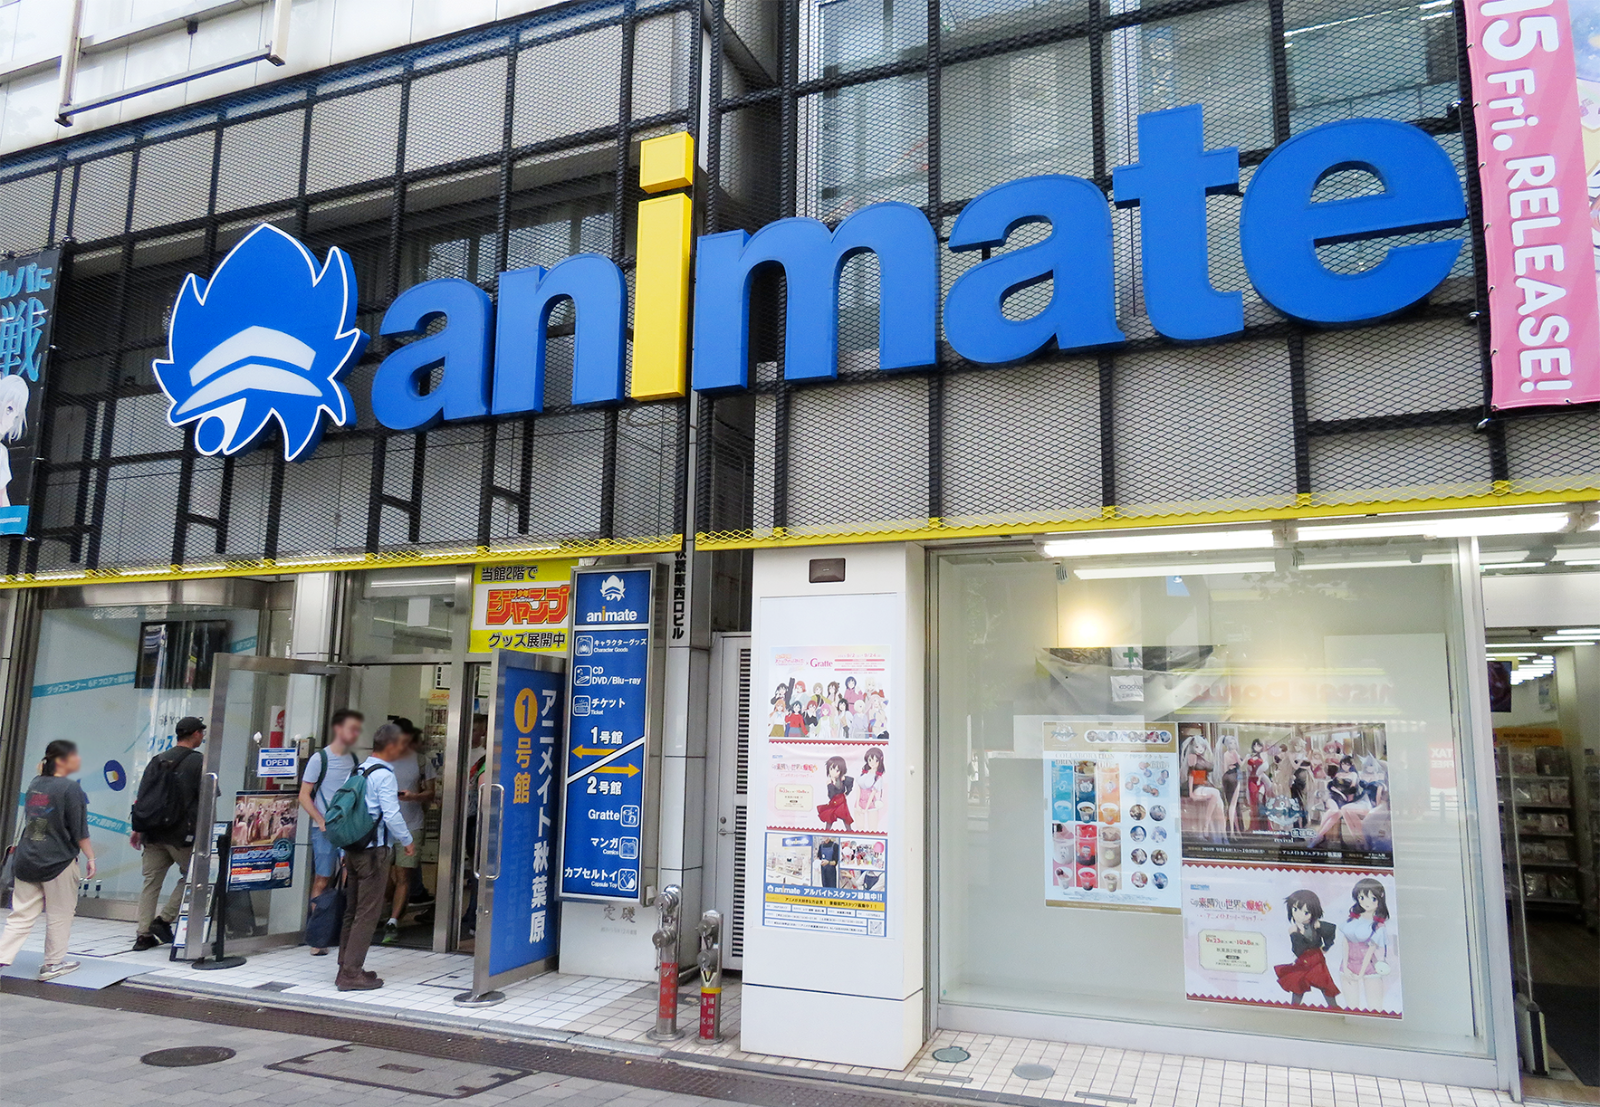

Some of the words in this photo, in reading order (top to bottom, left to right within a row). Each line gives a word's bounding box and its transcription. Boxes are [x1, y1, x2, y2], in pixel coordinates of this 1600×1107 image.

[1487, 68, 1539, 151] Fri.
[374, 104, 1467, 431] animate
[1504, 153, 1573, 393] RELEASE!
[481, 565, 539, 582] 当館2階で
[486, 584, 571, 625] ジャンプ
[586, 606, 638, 622] animate
[488, 631, 566, 649] グッズ展開中
[592, 666, 604, 675] CD
[810, 658, 833, 667] Gratte
[592, 676, 642, 686] DVD/Blu-ray
[591, 697, 626, 709] チケット
[590, 726, 623, 745] 1号館
[265, 759, 289, 767] OPEN
[587, 776, 623, 795] 2号館
[529, 689, 557, 944] アニメイト秋葉原
[588, 809, 620, 822] Gratte
[590, 837, 619, 849] マンガ
[564, 867, 618, 881] カプセルトイ
